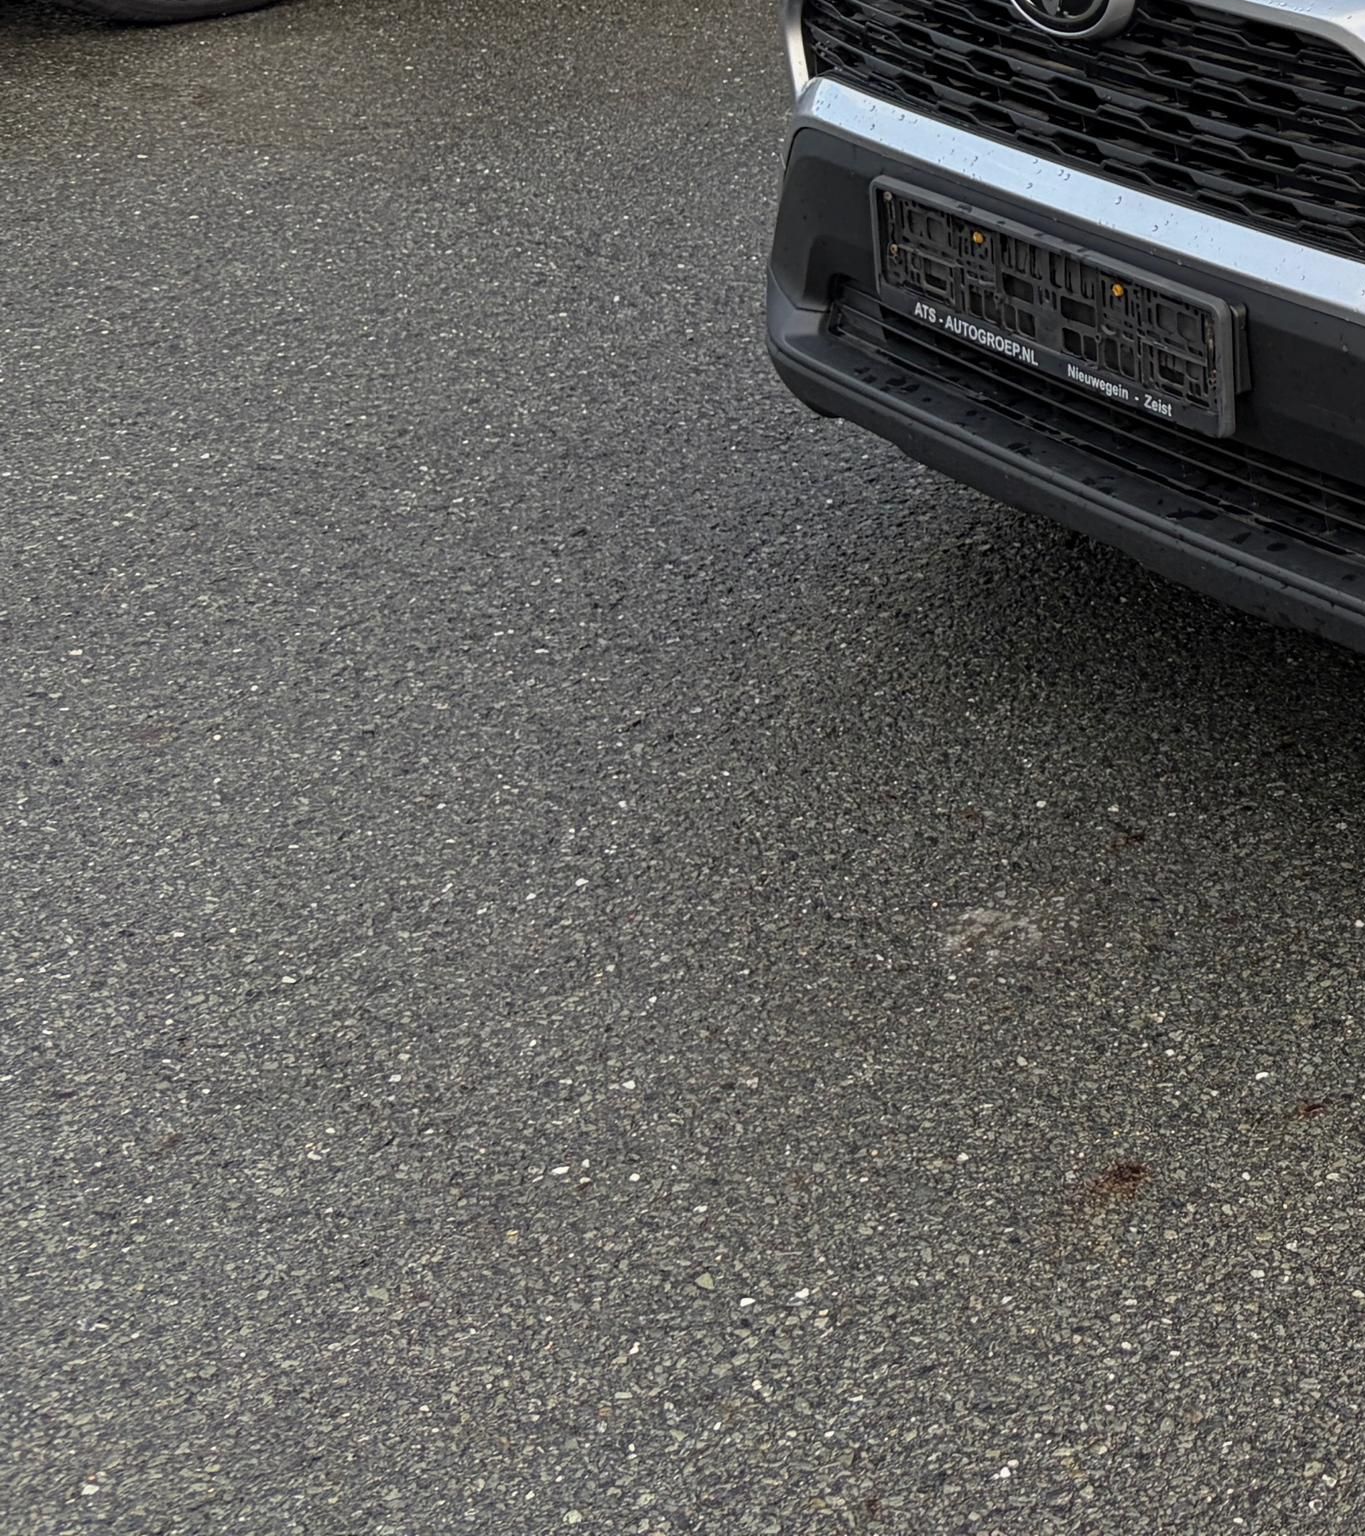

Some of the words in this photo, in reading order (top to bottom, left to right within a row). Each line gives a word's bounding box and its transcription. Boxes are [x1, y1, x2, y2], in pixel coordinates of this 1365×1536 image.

[914, 301, 937, 323] ATS
[944, 315, 1039, 366] AUTOGROEP.NL
[1067, 363, 1129, 400] Nieuwegein
[1143, 394, 1173, 417] Zeist
